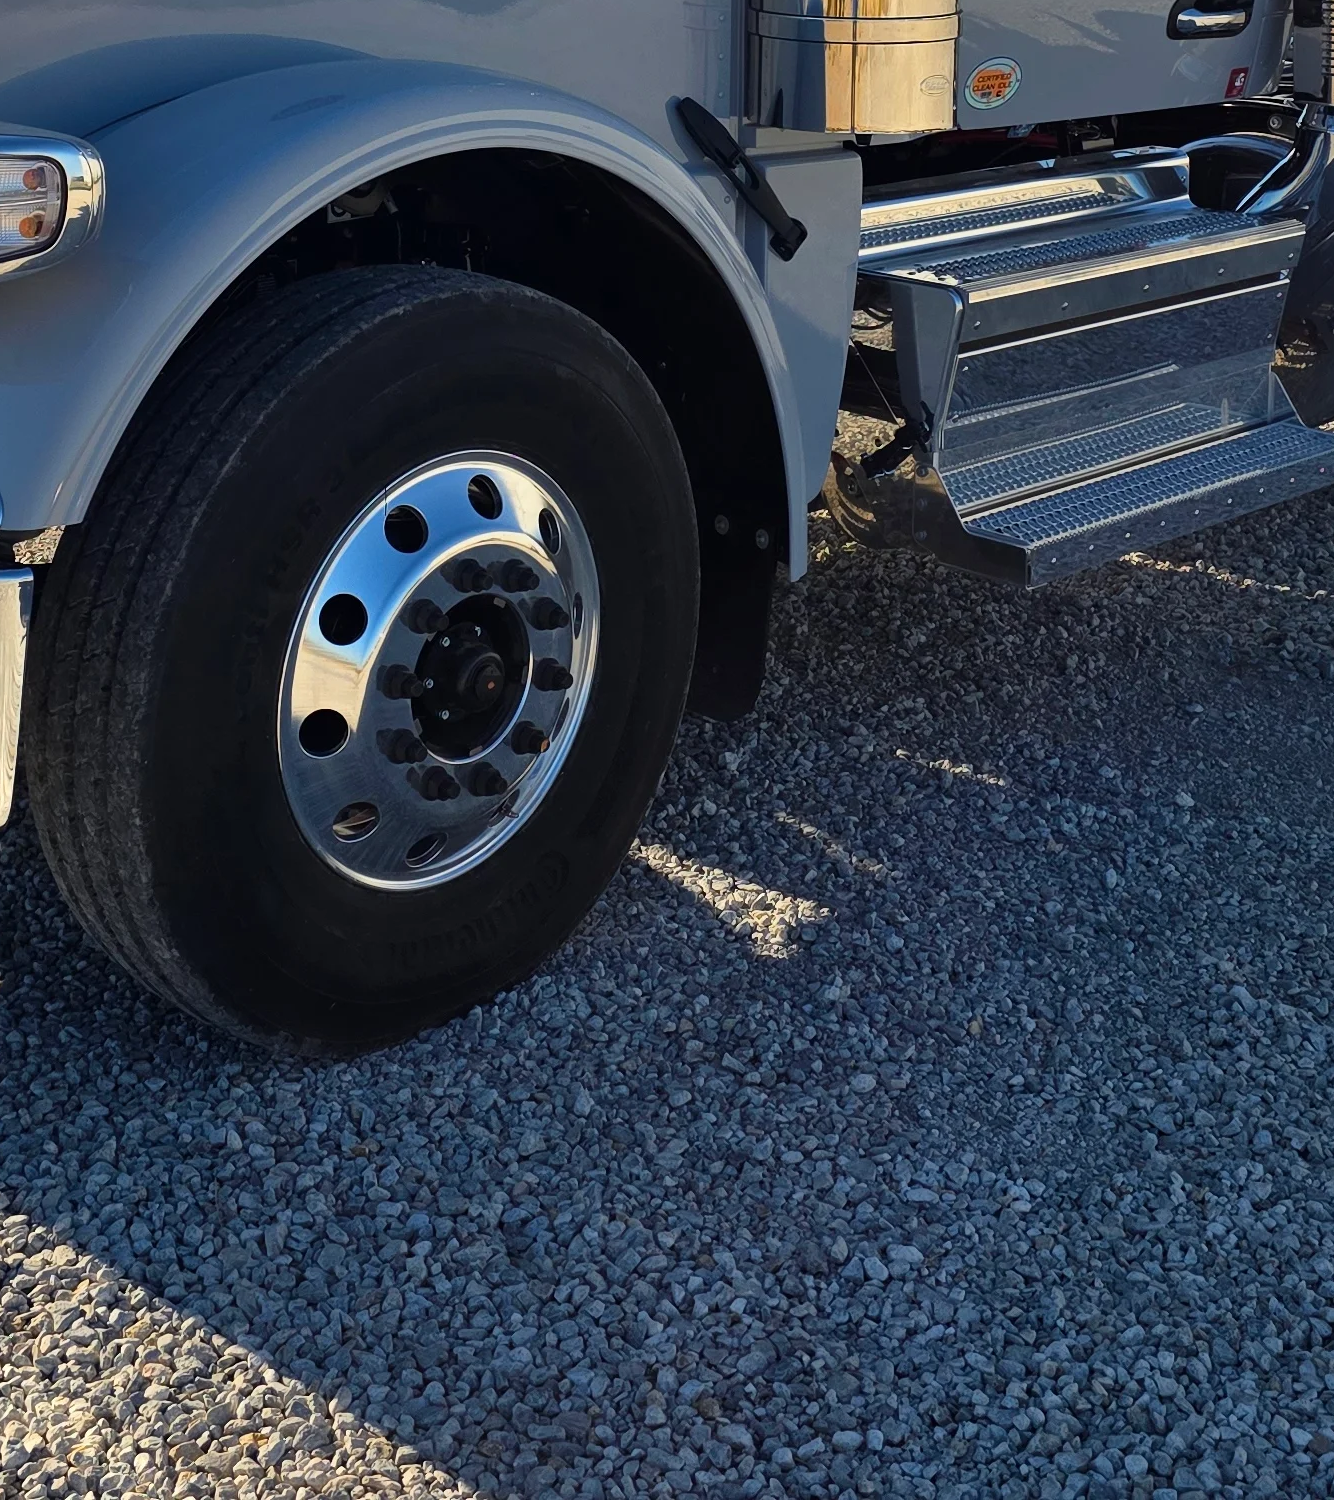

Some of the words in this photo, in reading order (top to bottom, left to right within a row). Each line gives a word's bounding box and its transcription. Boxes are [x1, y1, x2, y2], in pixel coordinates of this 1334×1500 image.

[977, 73, 1012, 84] CERTIFIED
[972, 83, 996, 93] CLEAN
[998, 81, 1014, 90] IDLE
